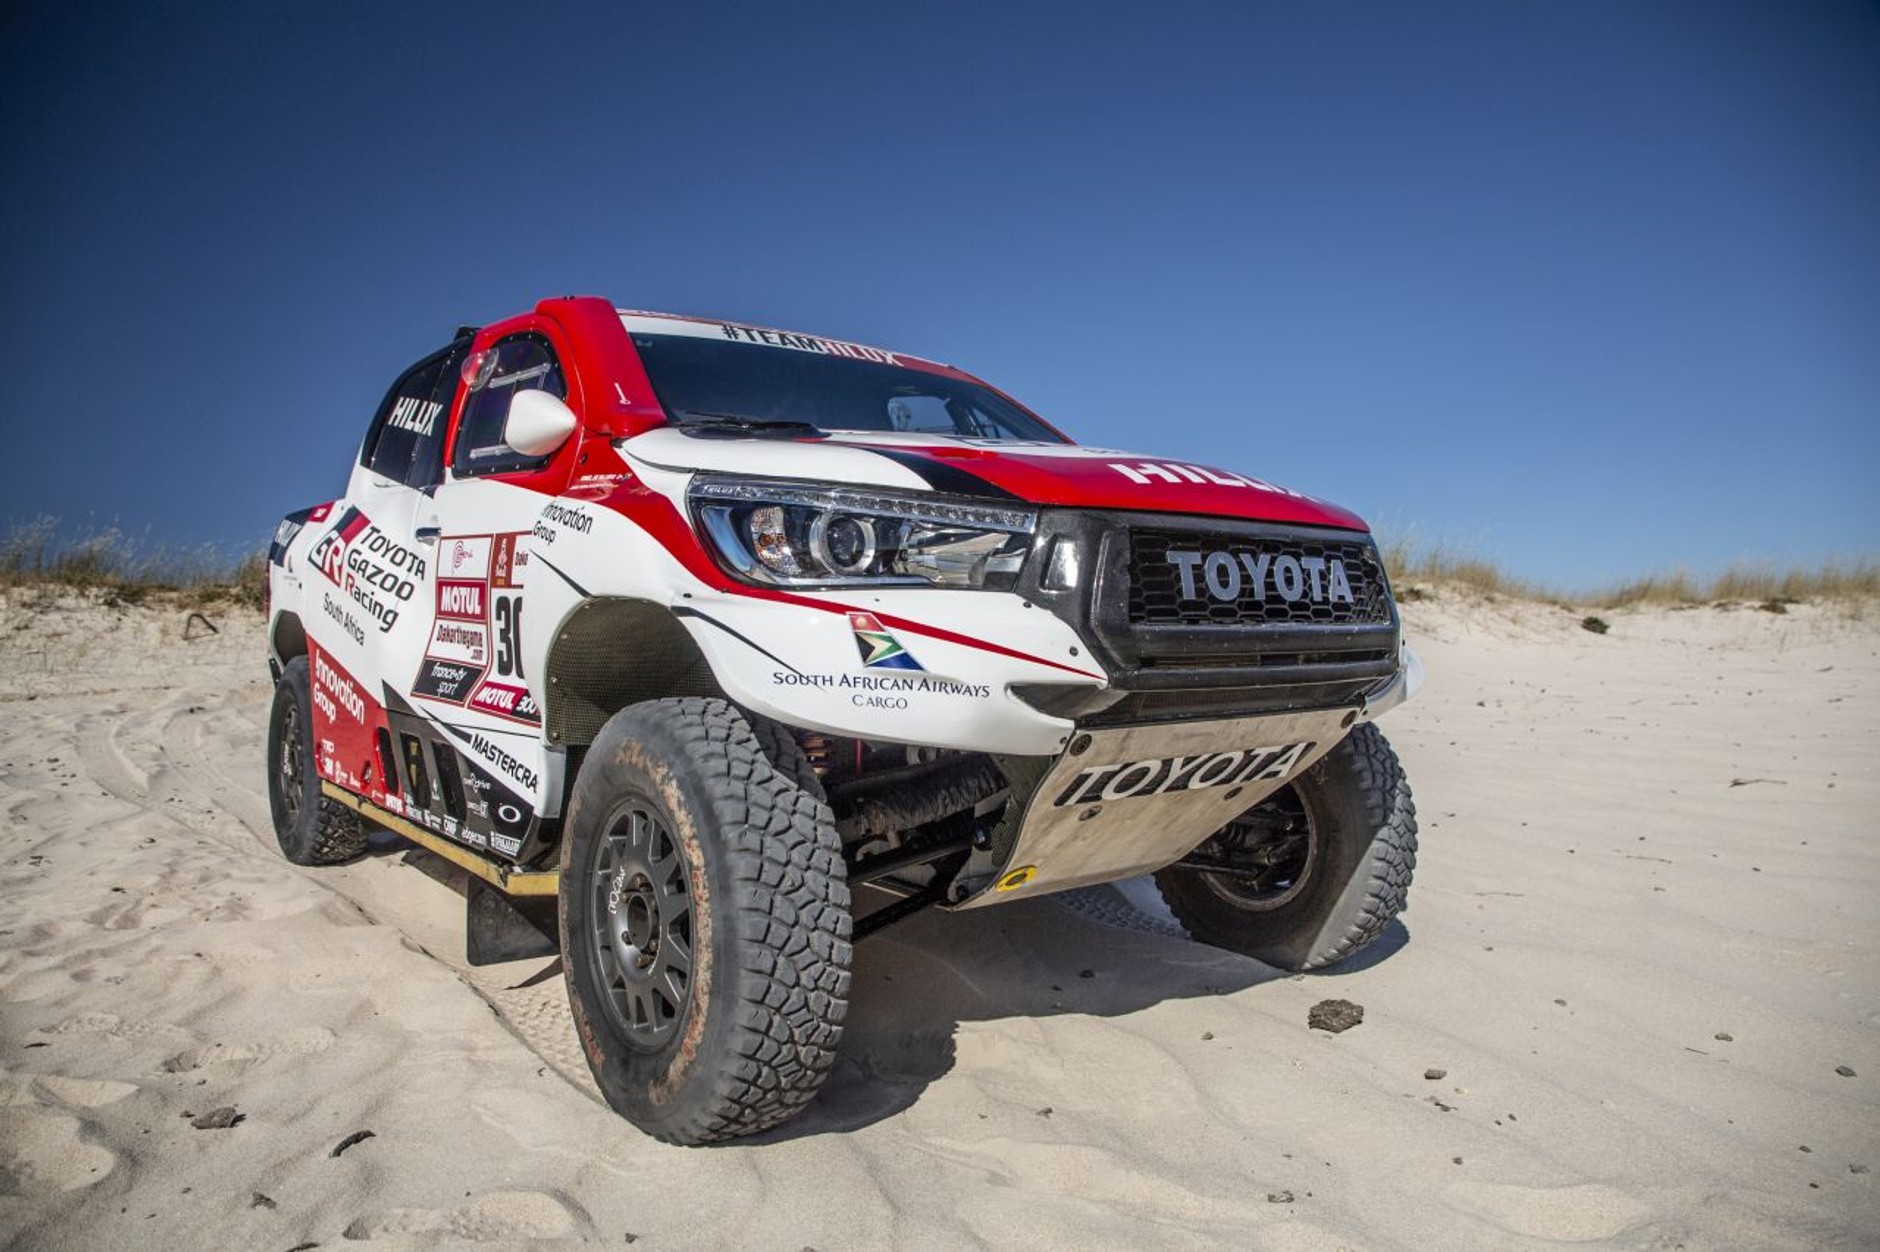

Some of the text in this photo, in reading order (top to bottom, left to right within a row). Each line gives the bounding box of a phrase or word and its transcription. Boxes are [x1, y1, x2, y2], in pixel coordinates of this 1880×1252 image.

[722, 324, 904, 366] #TEAMHILUX
[388, 397, 443, 436] HILUX
[347, 548, 415, 602] GAZOO
[360, 526, 426, 581] TOYOTA
[1166, 550, 1354, 603] TOYOTA
[323, 592, 366, 646] South Africa
[345, 572, 399, 633] Racing
[440, 586, 482, 615] MOTUL
[314, 681, 336, 725] Group
[315, 648, 365, 726] Innovation
[475, 686, 516, 709] MOTUL
[772, 671, 990, 699] SOUTH AFRICAN AIRWAYS
[851, 694, 909, 710] CARGO
[1062, 742, 1309, 806] TOYOTA
